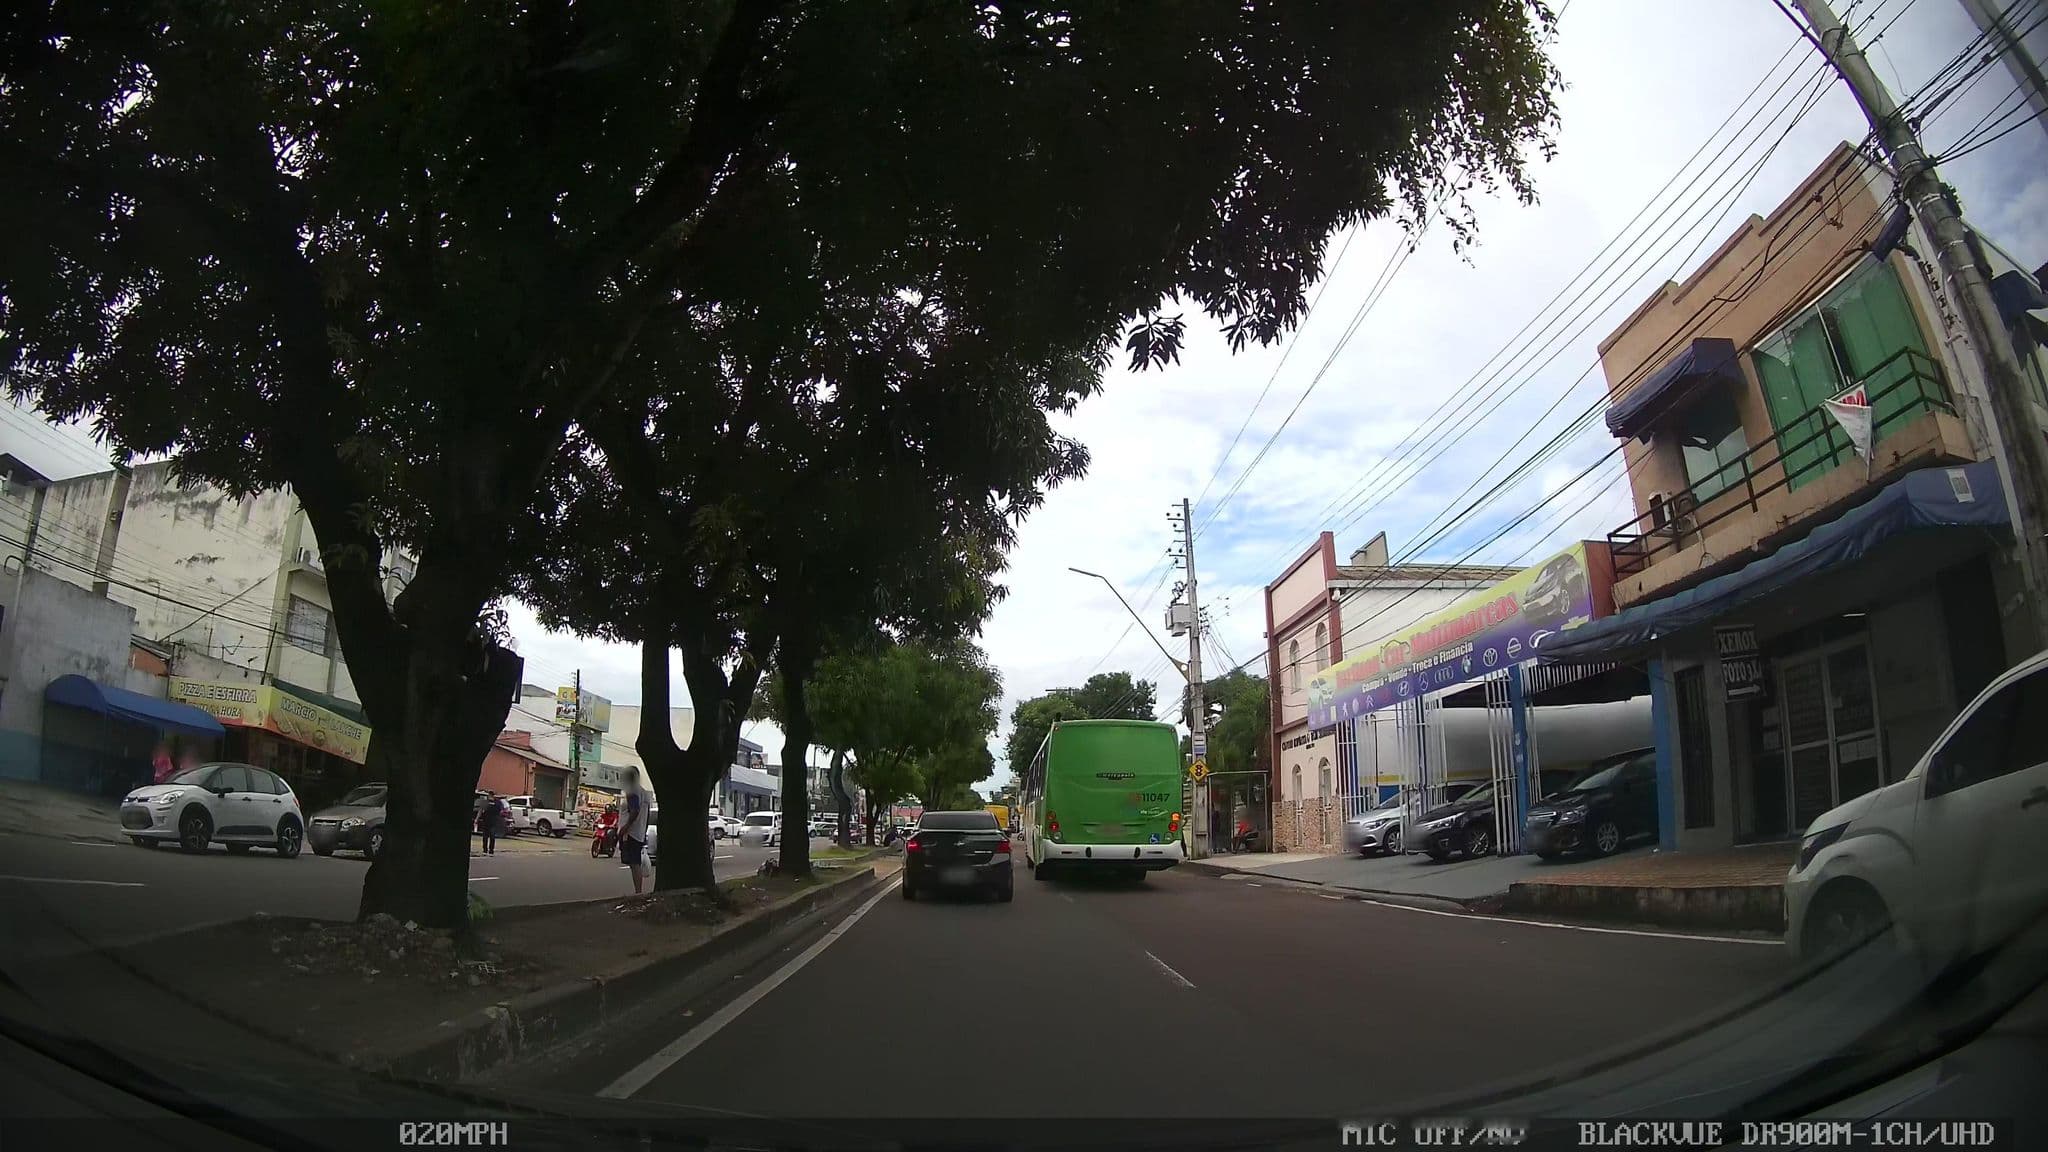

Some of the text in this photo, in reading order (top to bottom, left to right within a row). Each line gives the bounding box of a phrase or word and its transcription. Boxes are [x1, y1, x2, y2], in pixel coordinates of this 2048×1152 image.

[1412, 658, 1433, 674] Troca
[1439, 642, 1473, 664] Financia
[179, 682, 257, 704] PIZZA E ESFIRRA
[220, 705, 241, 718] HORA
[1142, 793, 1170, 802] 11047
